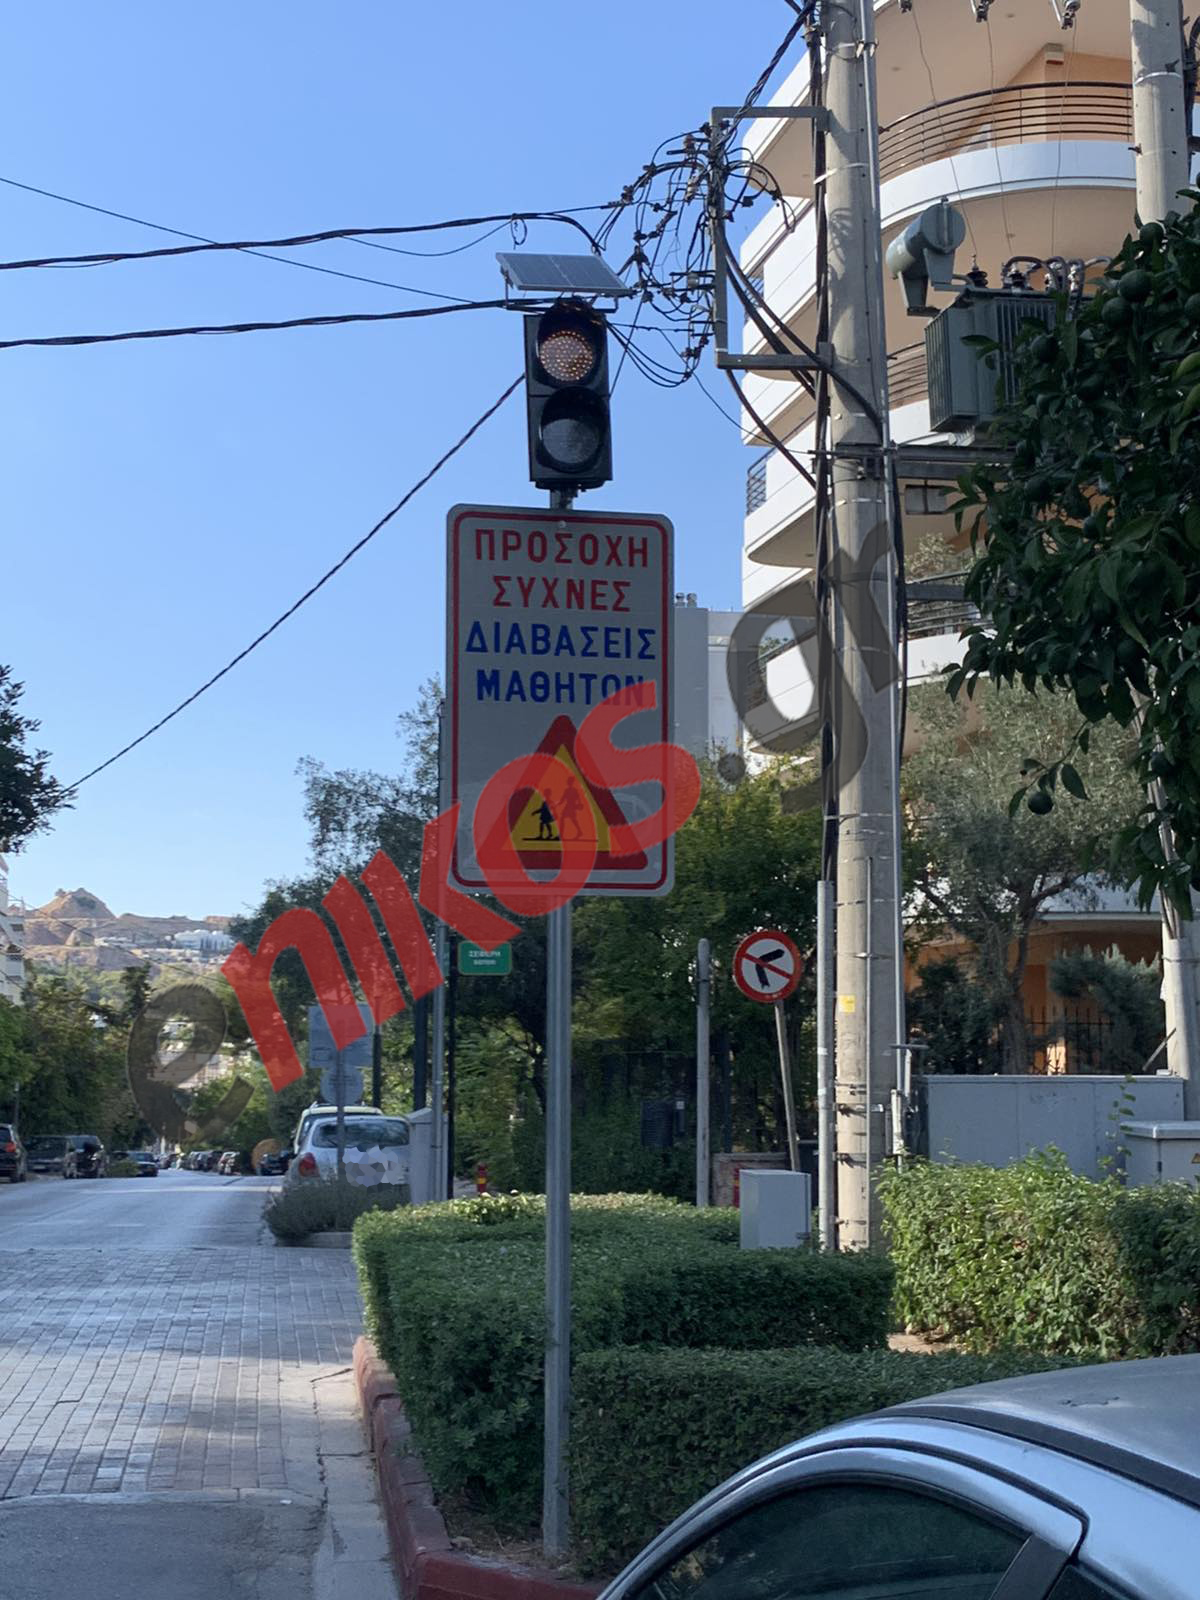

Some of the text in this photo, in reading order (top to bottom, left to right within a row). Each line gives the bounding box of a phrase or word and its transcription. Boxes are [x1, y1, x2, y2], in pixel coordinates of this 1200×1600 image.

[475, 528, 649, 567] ΠΡΟΣΟΧΗ
[492, 575, 631, 612] ΣΥΧΝΕΣ
[465, 620, 657, 660] ΔΙΑΒΑΣΕΙΣ
[476, 668, 644, 707] ΜΑΘΗΤΩΝ
